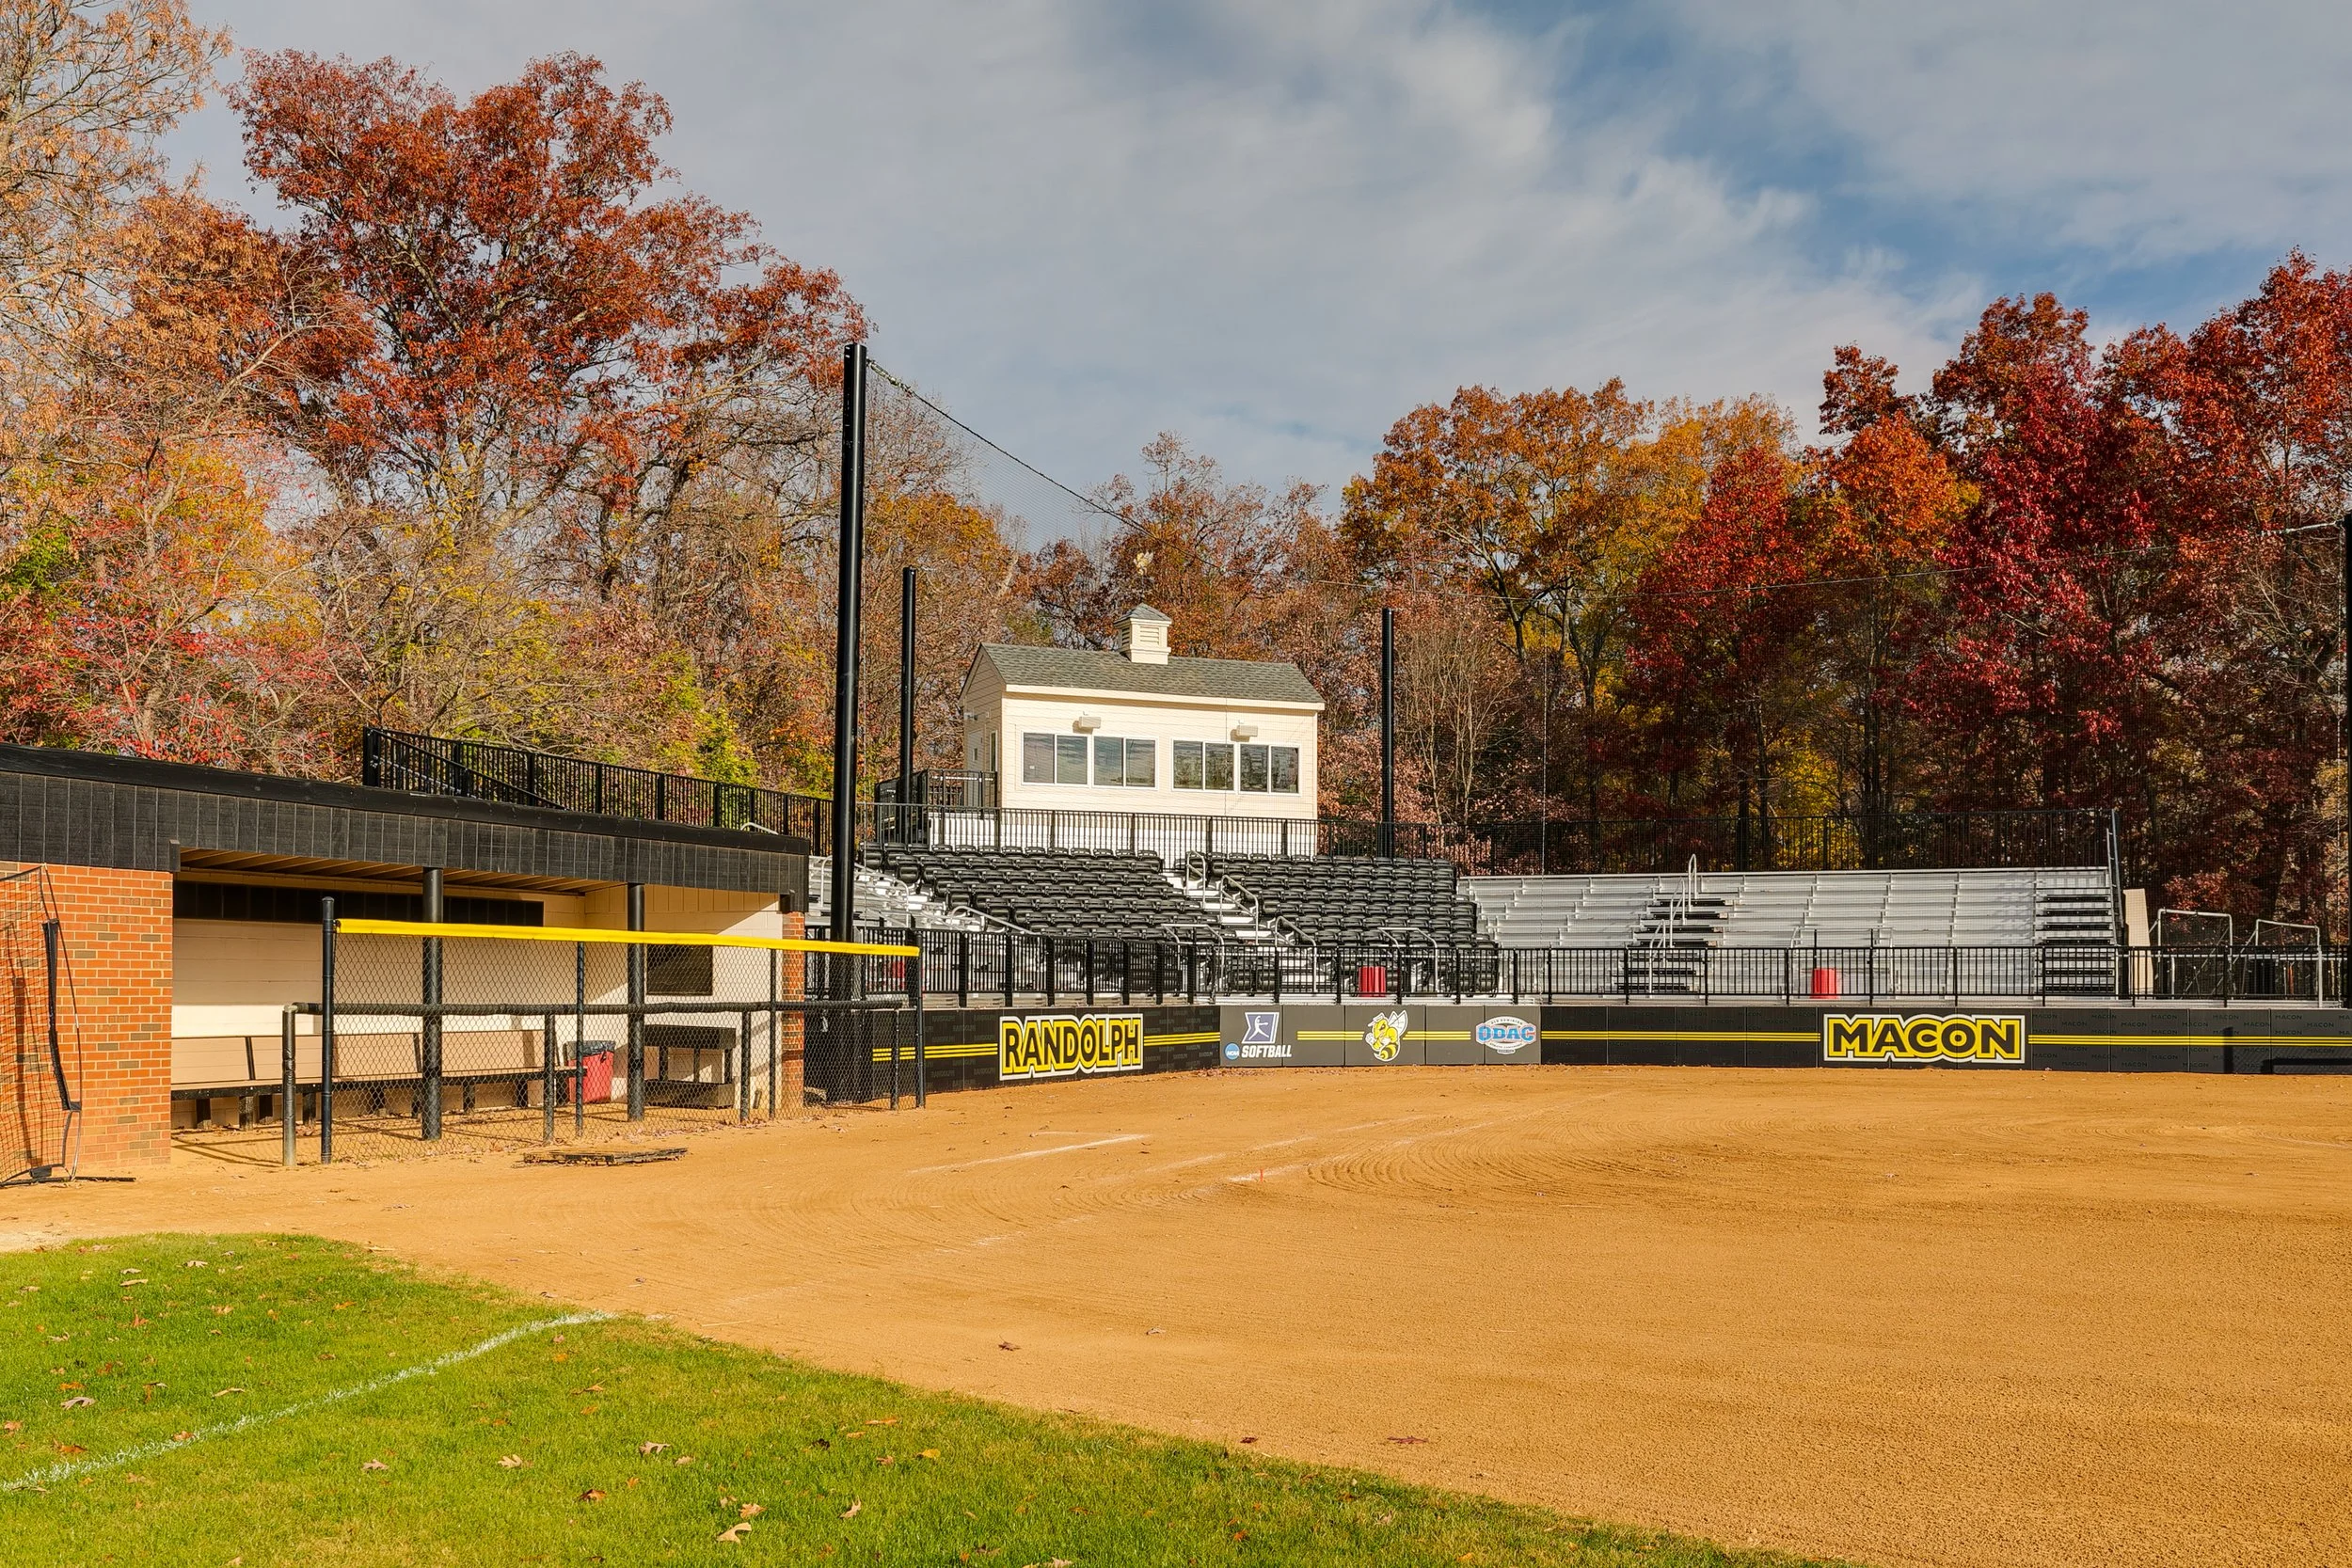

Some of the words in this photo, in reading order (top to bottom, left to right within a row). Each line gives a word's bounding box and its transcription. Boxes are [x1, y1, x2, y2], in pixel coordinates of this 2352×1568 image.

[1000, 1016, 1143, 1076] RANDOLPH
[1477, 1024, 1535, 1042] ODAC
[1826, 1016, 2022, 1061] MACON
[1241, 1045, 1293, 1058] SOFTBALL
